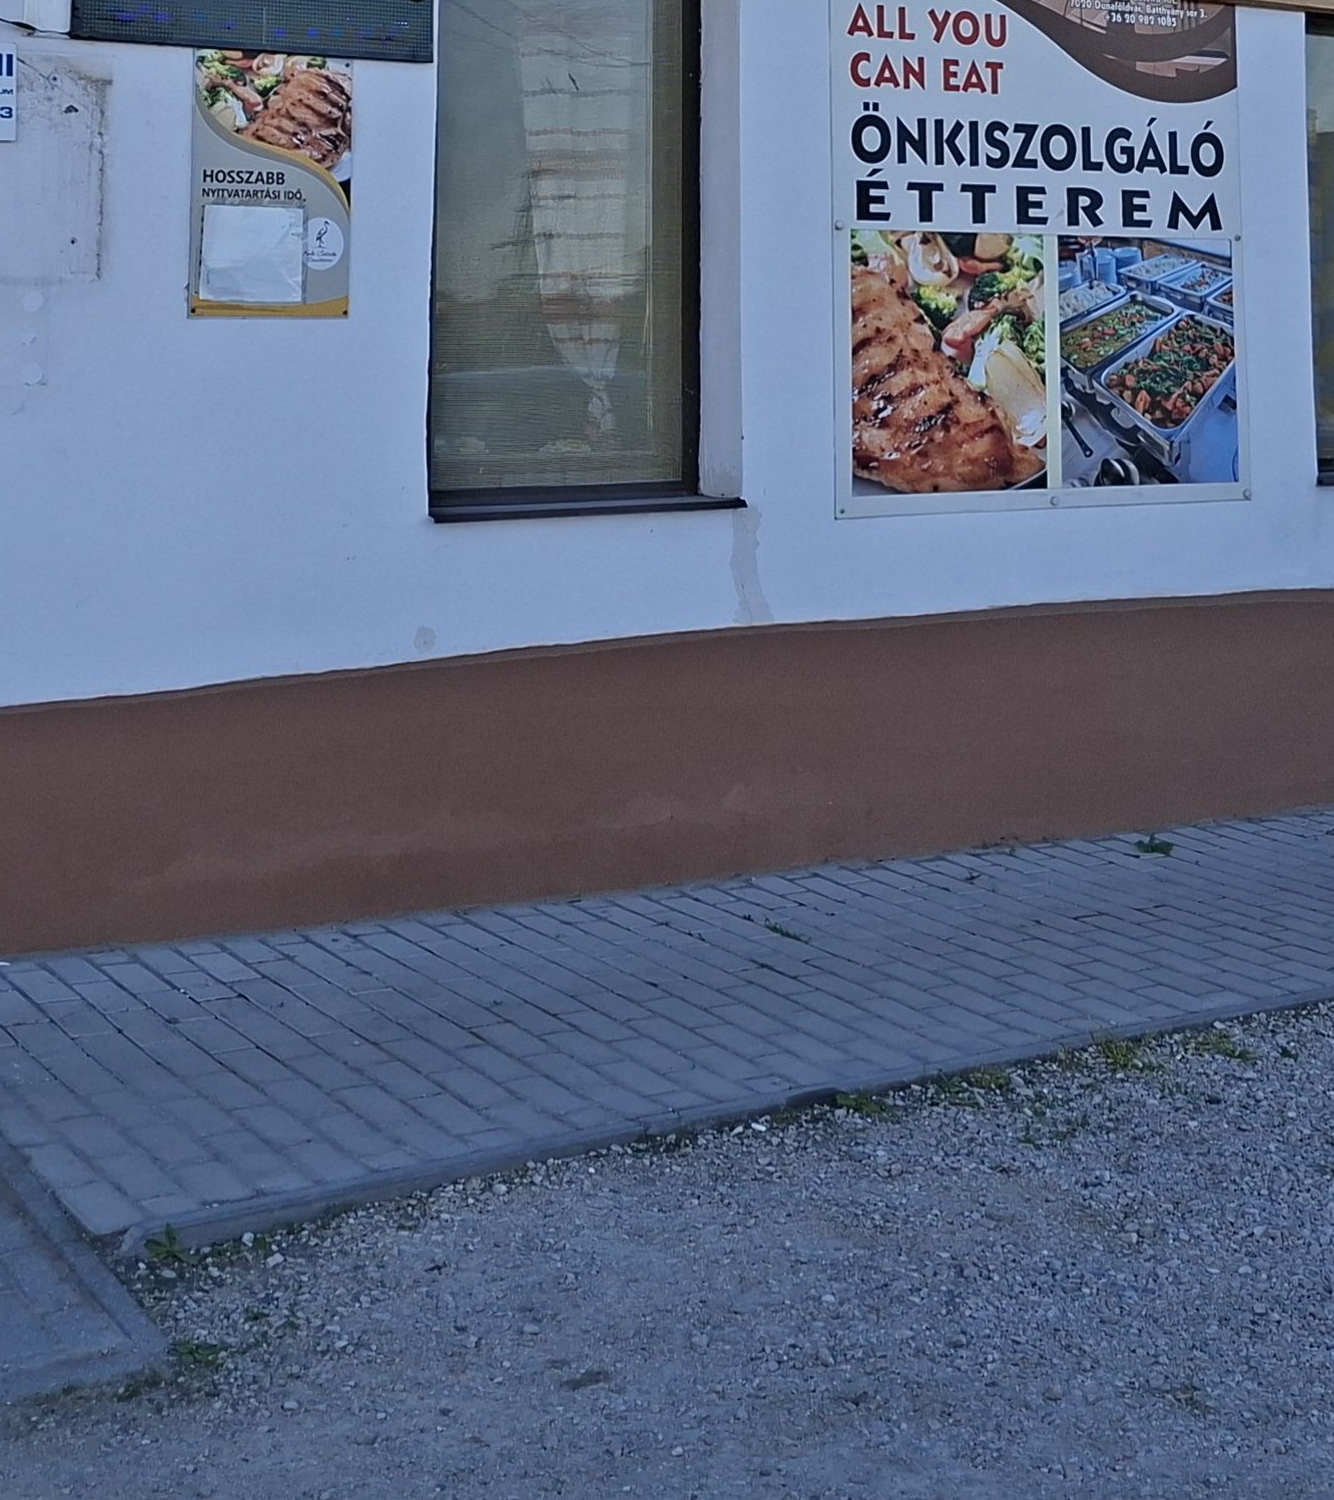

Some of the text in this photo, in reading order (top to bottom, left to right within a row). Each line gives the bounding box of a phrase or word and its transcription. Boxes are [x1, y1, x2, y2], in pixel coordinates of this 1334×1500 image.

[847, 2, 1007, 48] ALL YOU
[1124, 13, 1136, 24] 20
[850, 51, 1004, 95] CAN EAT
[851, 101, 1225, 177] ÖNKISZOLGÁLÓ
[201, 187, 281, 201] NYITVATARTÁSI
[202, 169, 286, 186] HOSSZABB
[855, 168, 1223, 232] ÉTTEREM
